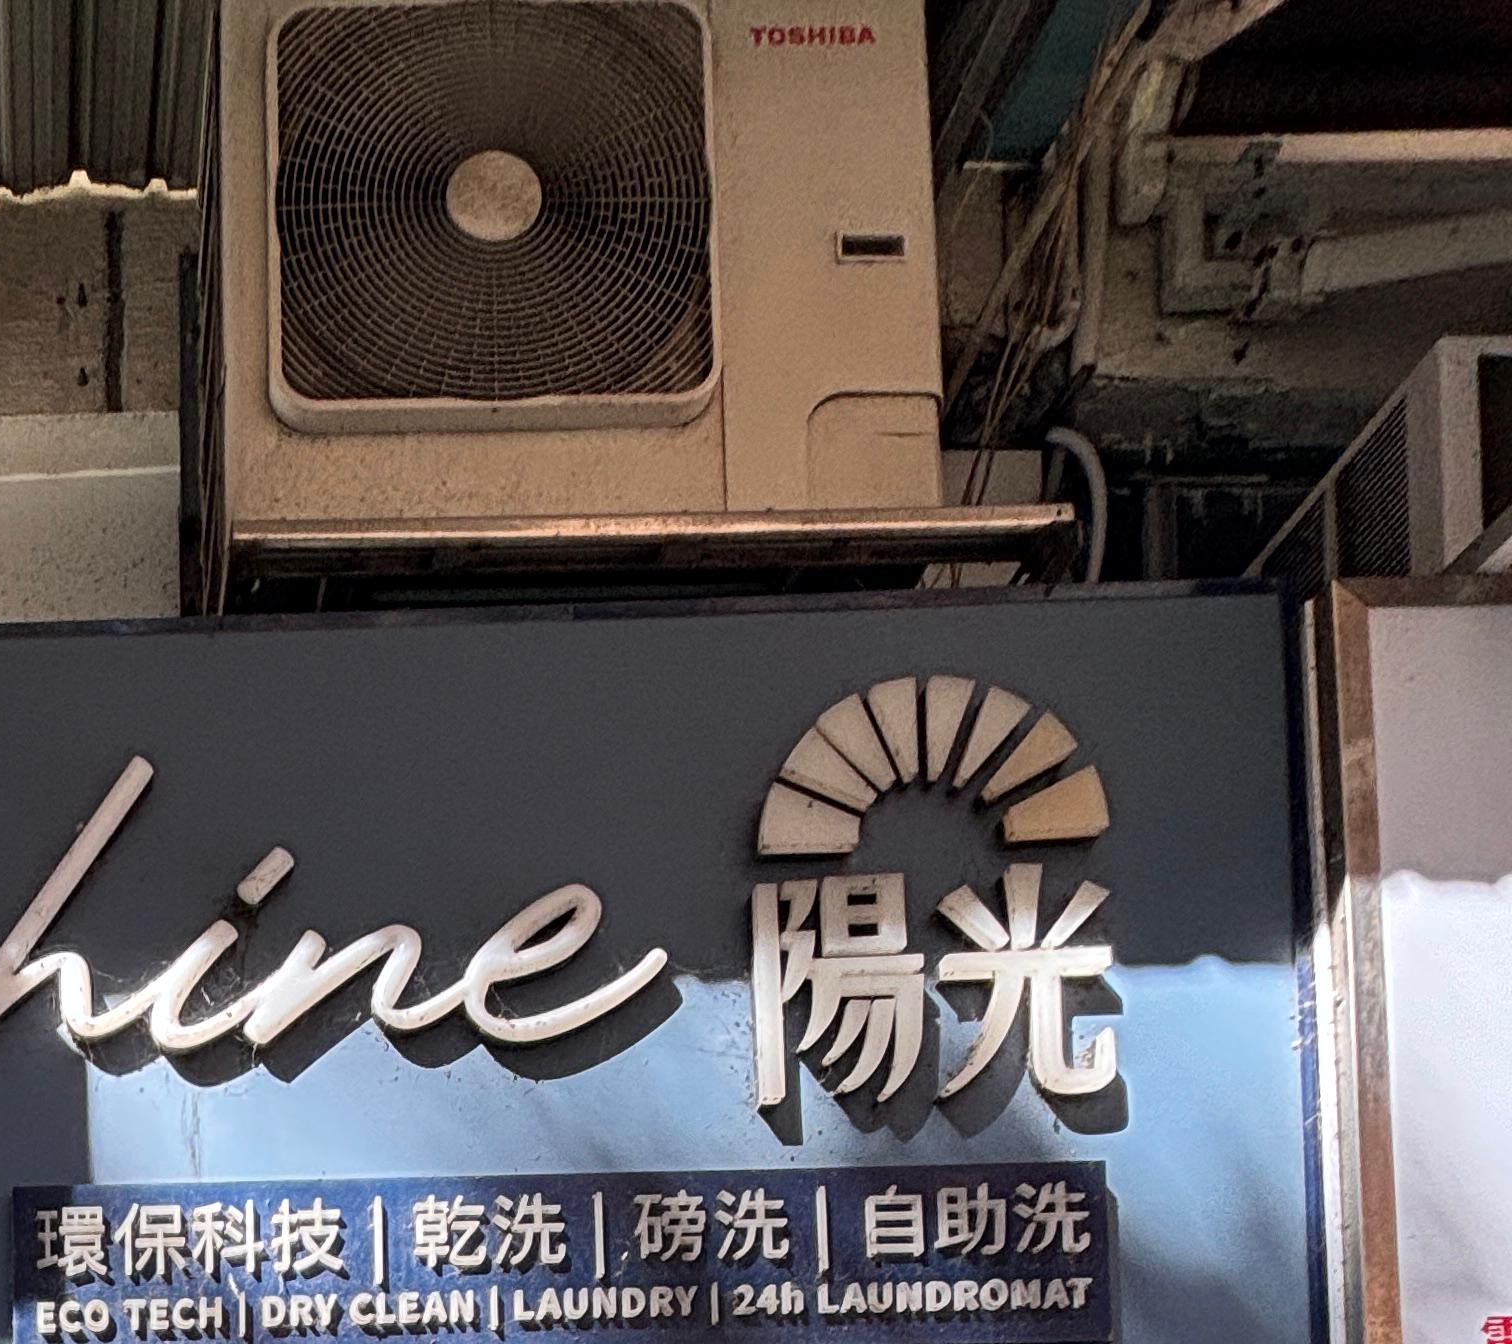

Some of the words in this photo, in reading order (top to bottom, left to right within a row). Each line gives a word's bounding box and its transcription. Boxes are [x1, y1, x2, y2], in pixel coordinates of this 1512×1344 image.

[750, 25, 876, 47] TOSHIBA
[750, 862, 1118, 1110] 陽光
[36, 1196, 345, 1278] 環保科技
[412, 1191, 568, 1268] 乾洗
[633, 1187, 790, 1261] 磅洗
[864, 1180, 1092, 1259] 自助洗
[36, 1298, 111, 1335] ECO
[125, 1296, 224, 1332] TECH
[261, 1293, 345, 1329] DRY
[349, 1289, 476, 1325] CLEAN
[513, 1284, 700, 1323] LAUNDRY
[732, 1279, 805, 1317] 24h
[816, 1276, 1094, 1316] LAUNDROMAT
